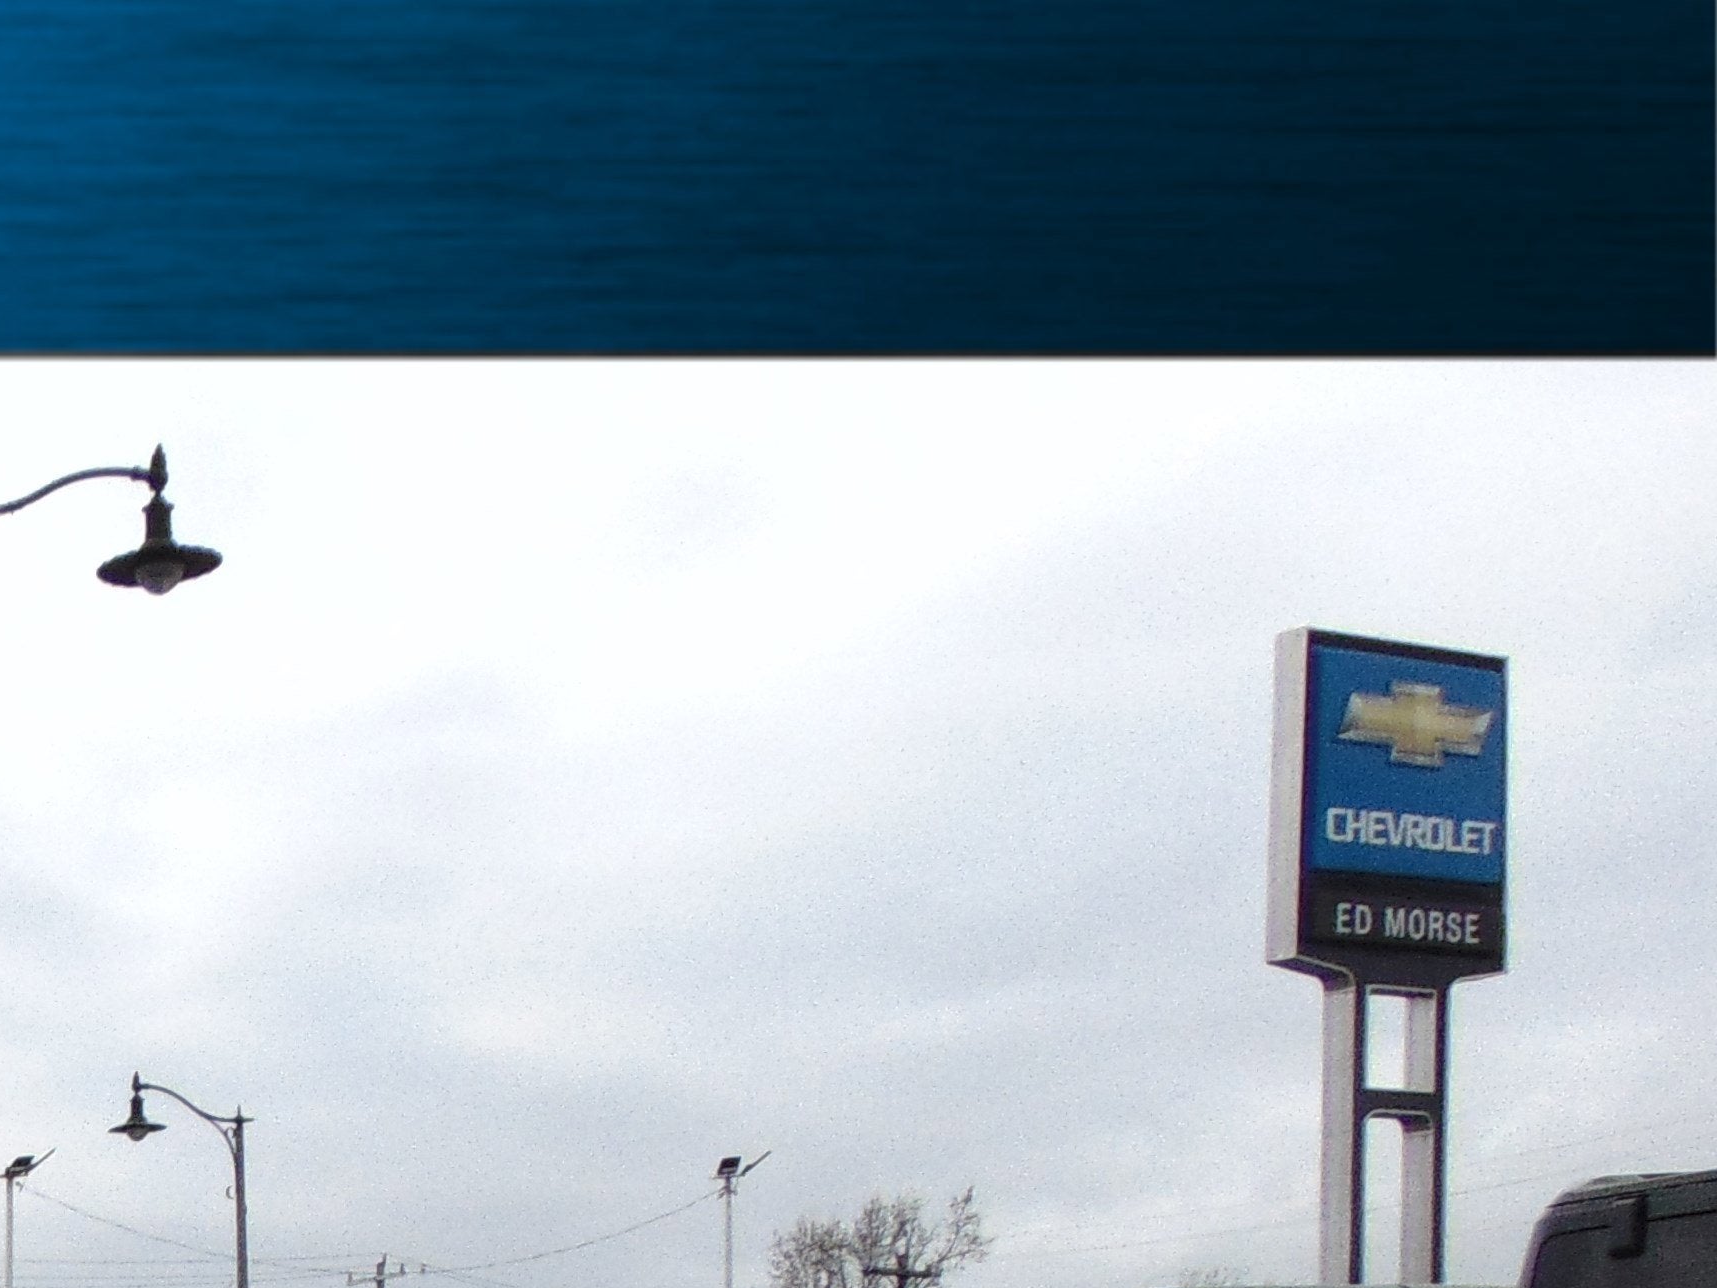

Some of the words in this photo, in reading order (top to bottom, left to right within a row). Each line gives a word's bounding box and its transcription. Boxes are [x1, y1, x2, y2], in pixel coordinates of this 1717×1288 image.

[1326, 807, 1496, 855] CHEVROLET
[1336, 902, 1372, 936] ED
[1384, 907, 1481, 944] MORSE
